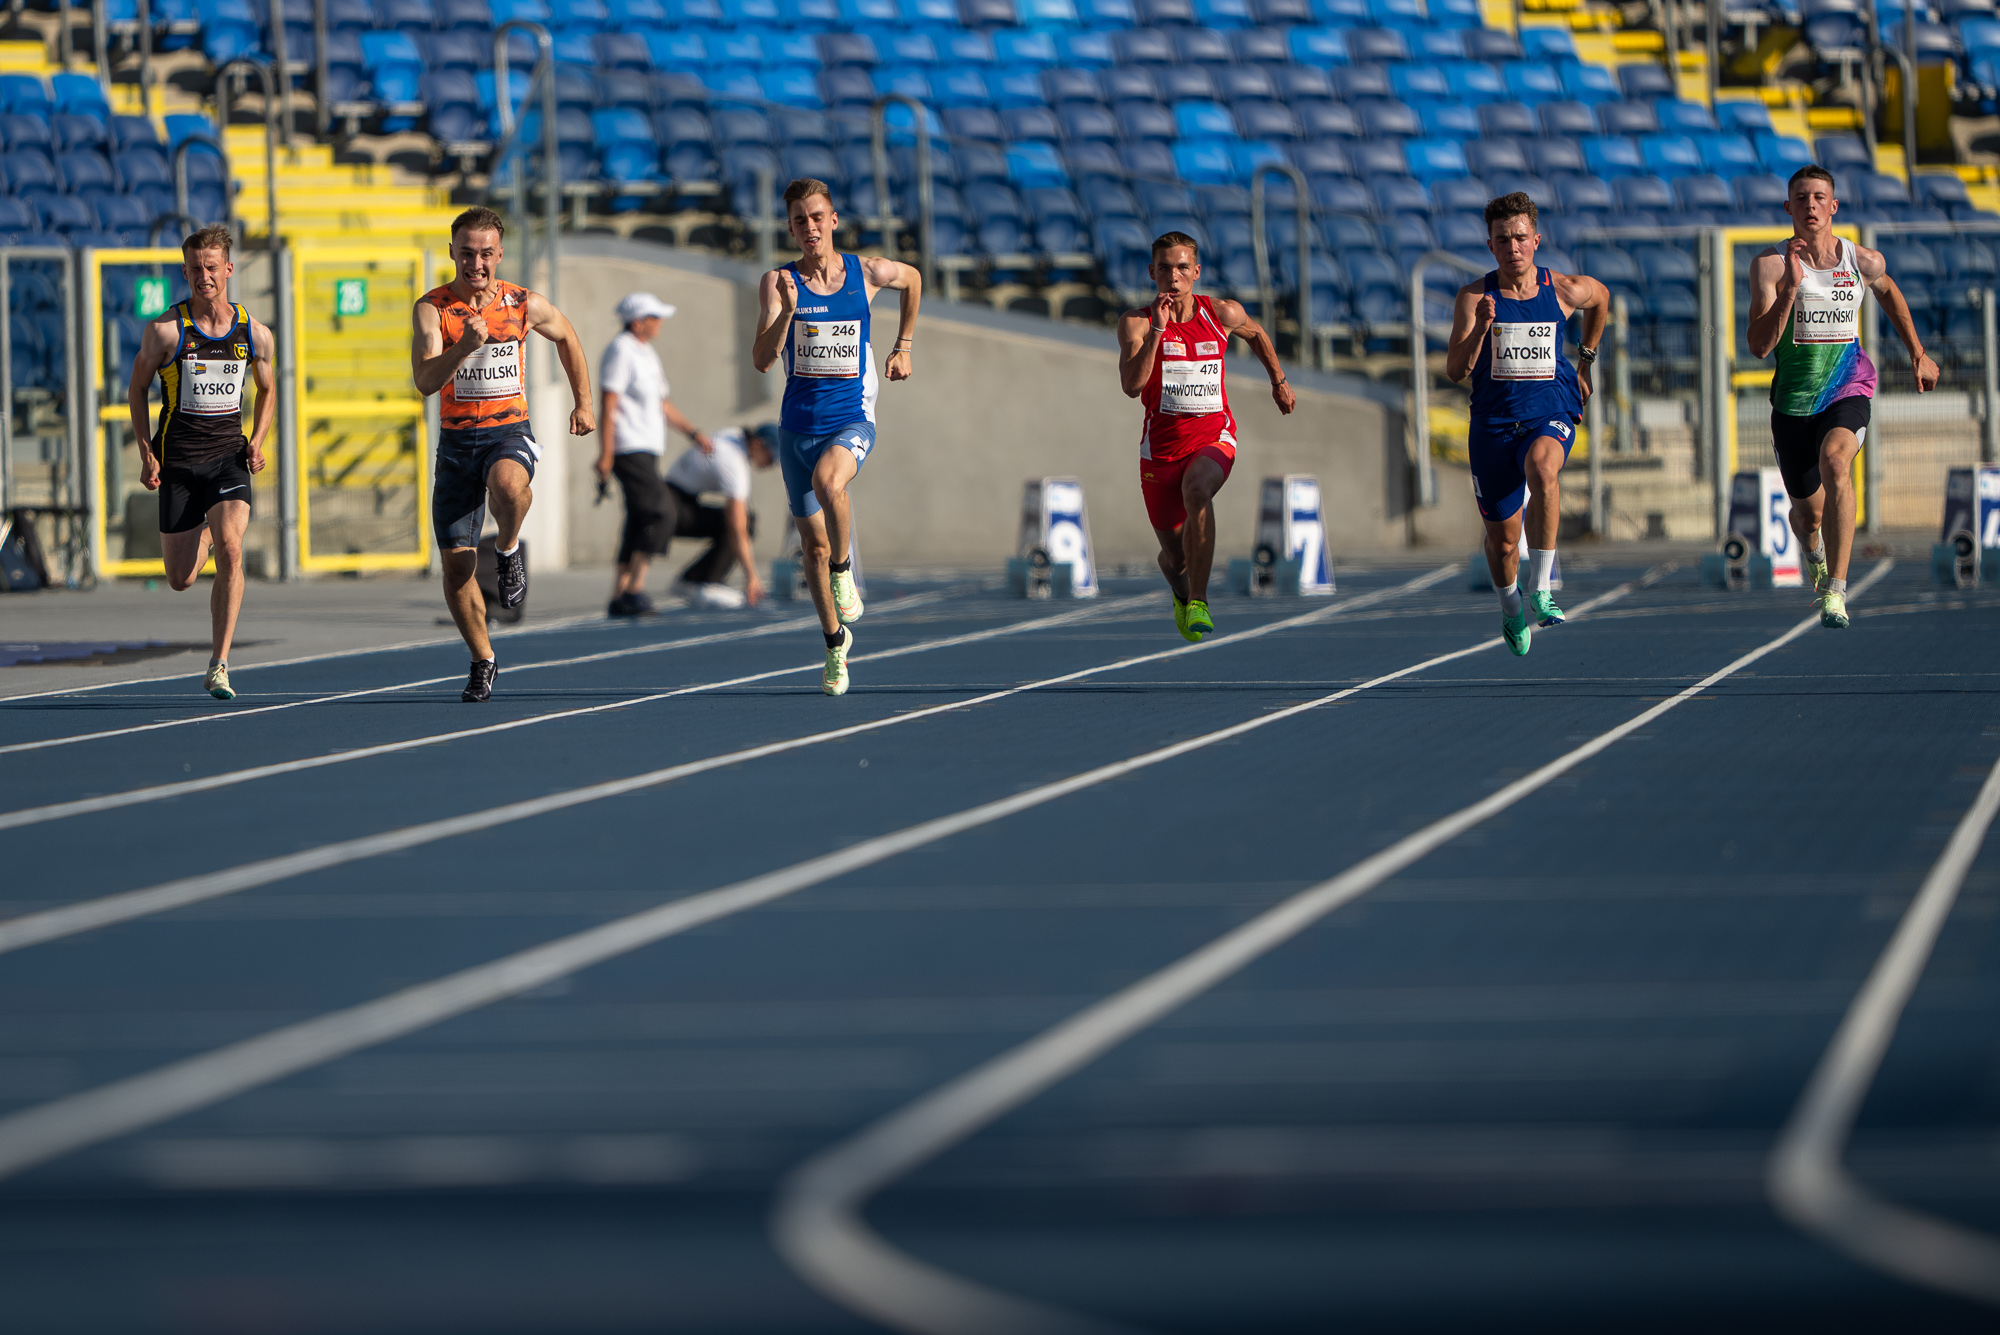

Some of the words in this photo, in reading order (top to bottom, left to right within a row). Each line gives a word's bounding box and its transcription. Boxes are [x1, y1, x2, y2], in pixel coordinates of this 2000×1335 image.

[1833, 270, 1851, 278] MKS
[140, 280, 165, 315] 24
[1831, 290, 1854, 301] 306
[1796, 307, 1854, 324] BUCZYŃSKI
[832, 324, 856, 337] 246
[1528, 326, 1551, 337] 632
[491, 345, 514, 358] 362
[797, 342, 858, 358] ŁUCZYŃSKI
[1496, 346, 1551, 360] LATOSIK
[223, 363, 239, 374] 88
[456, 364, 518, 381] MATULSKI
[1200, 363, 1219, 375] 478
[193, 383, 235, 395] ŁYSKO
[1164, 381, 1220, 397] NAWOTCZYŃSKI
[1769, 492, 1790, 556] 5
[1290, 520, 1324, 585] 7
